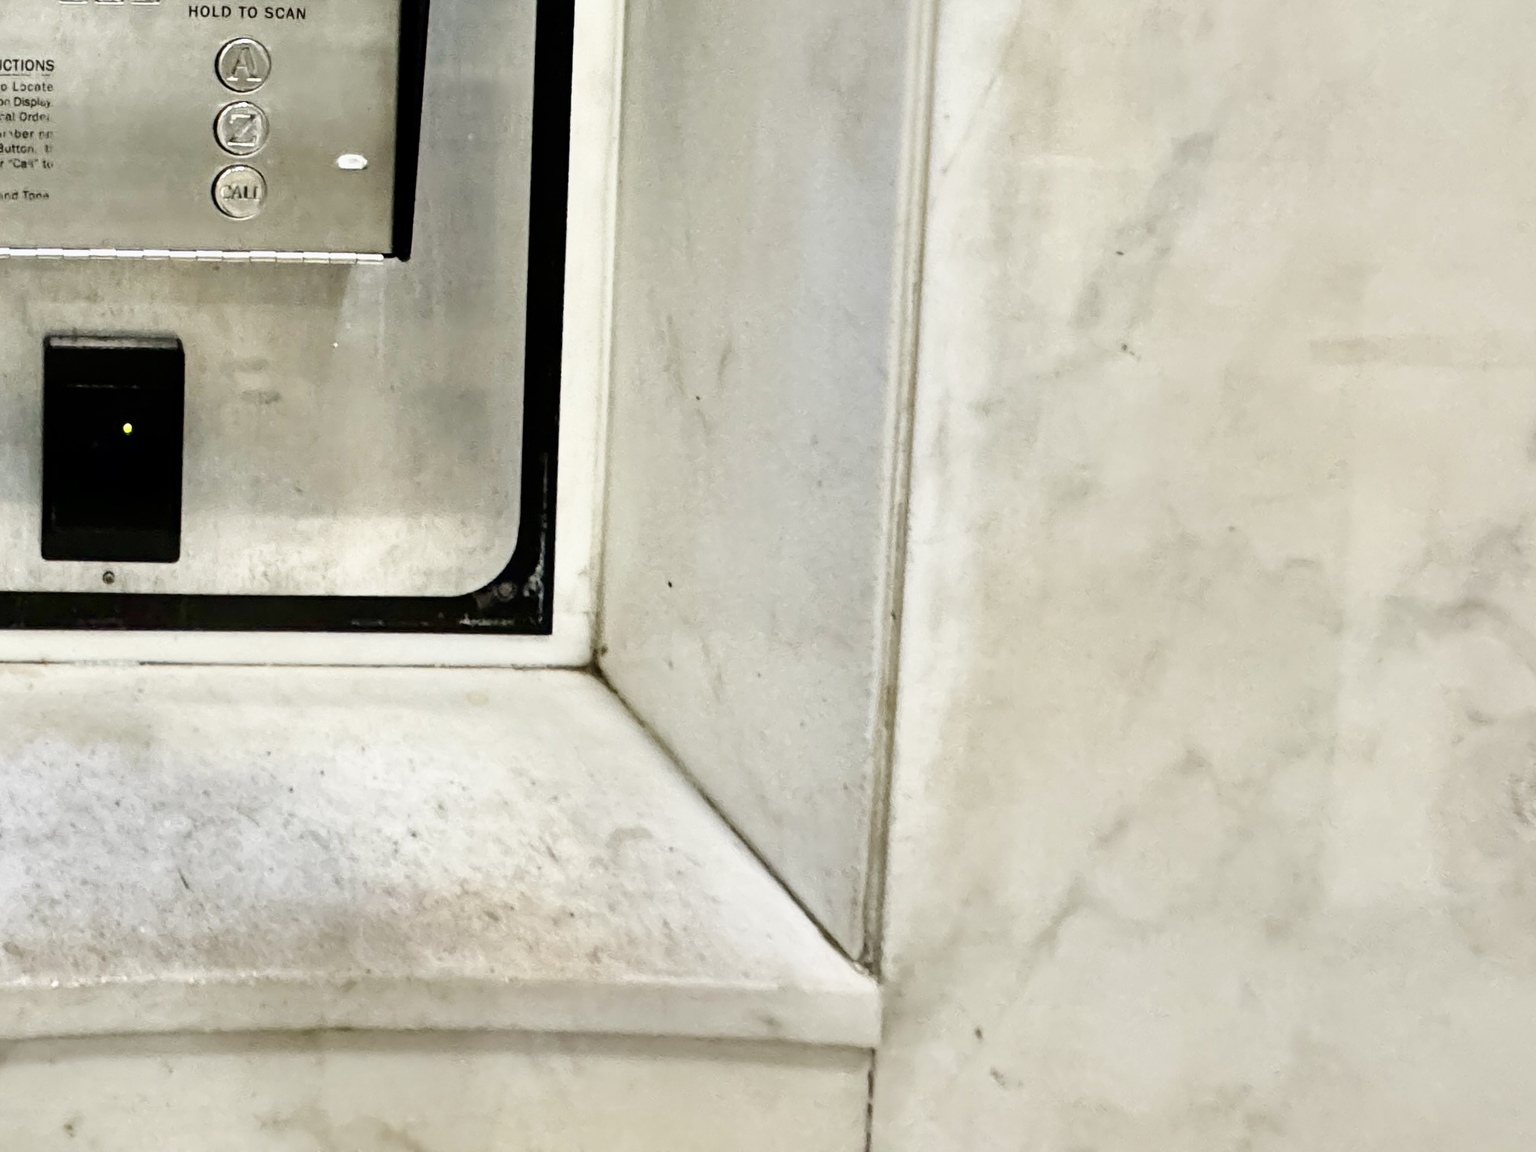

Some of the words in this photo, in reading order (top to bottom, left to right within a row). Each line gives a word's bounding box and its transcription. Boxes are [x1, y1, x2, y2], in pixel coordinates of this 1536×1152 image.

[188, 5, 232, 18] HOLD
[238, 6, 258, 19] TO
[264, 6, 306, 20] SCAN
[226, 46, 262, 82] A
[13, 81, 54, 92] Locate
[226, 113, 258, 147] Z
